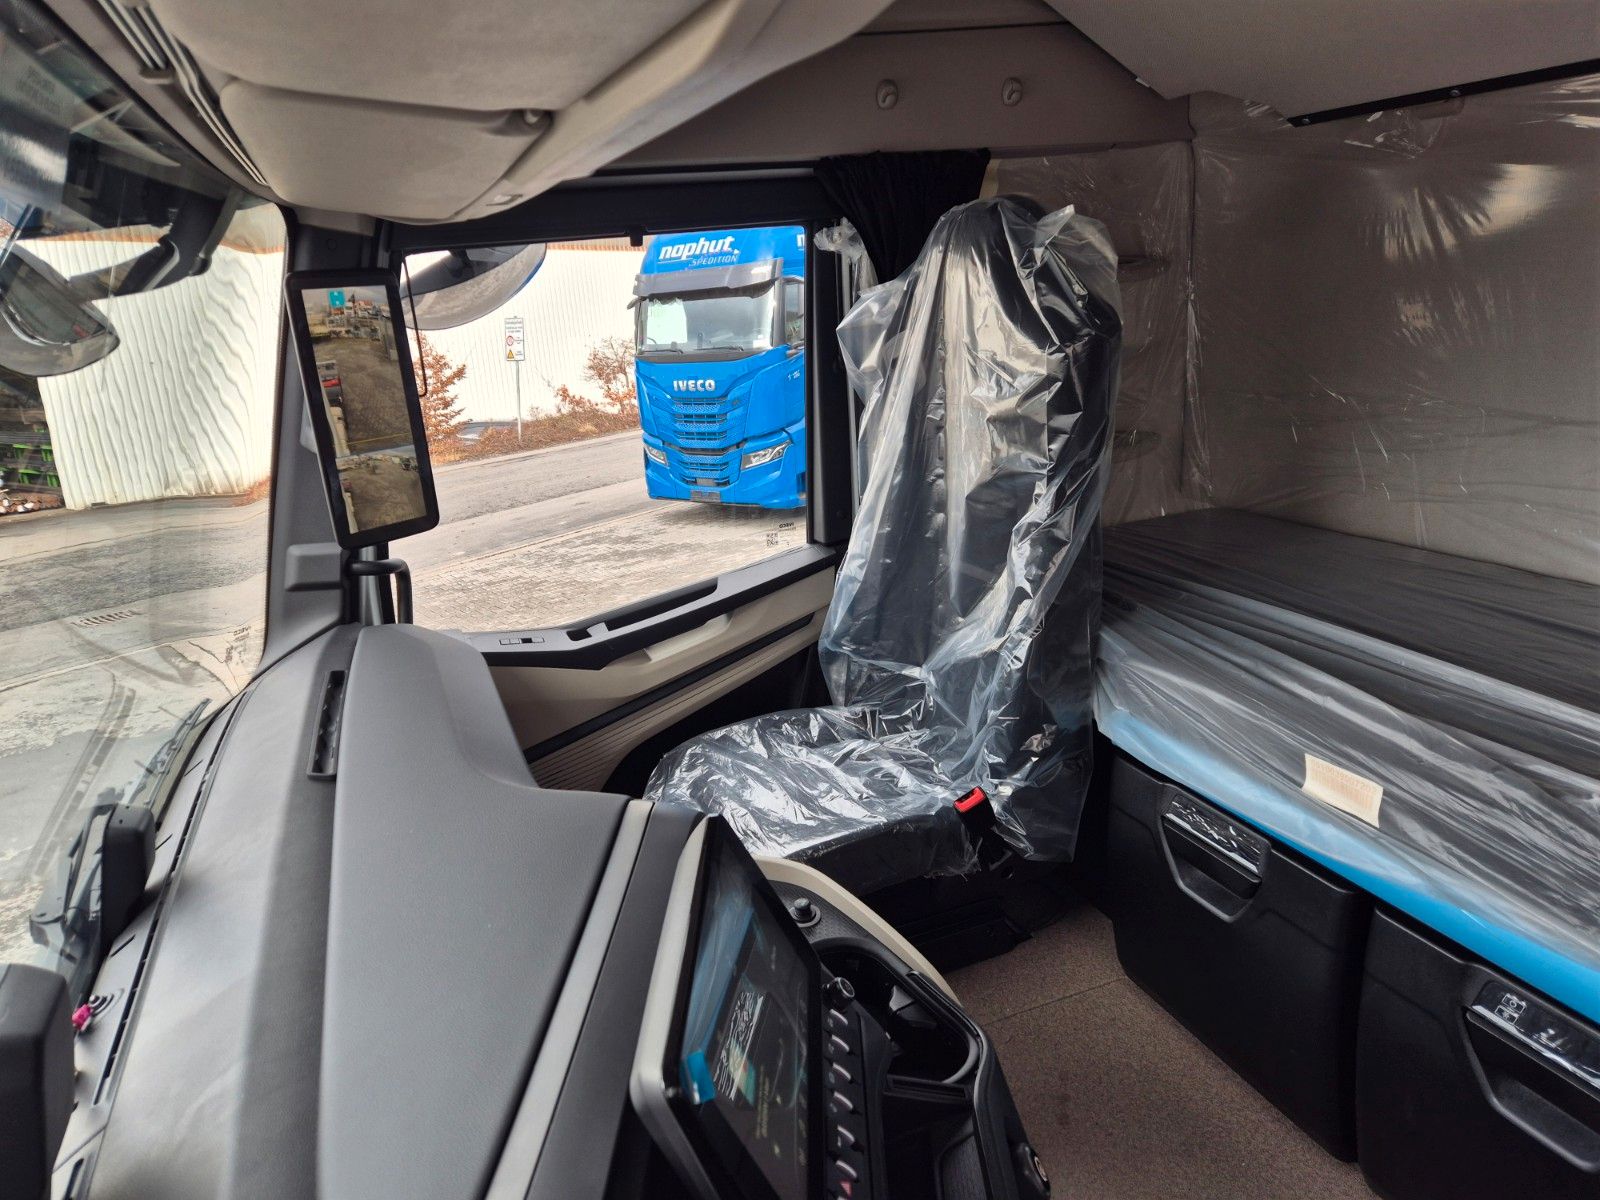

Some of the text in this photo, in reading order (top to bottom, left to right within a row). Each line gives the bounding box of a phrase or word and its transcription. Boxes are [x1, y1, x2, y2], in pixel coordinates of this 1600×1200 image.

[658, 235, 735, 260] nophut
[691, 255, 738, 266] SPEDITION
[673, 379, 716, 392] IVECO
